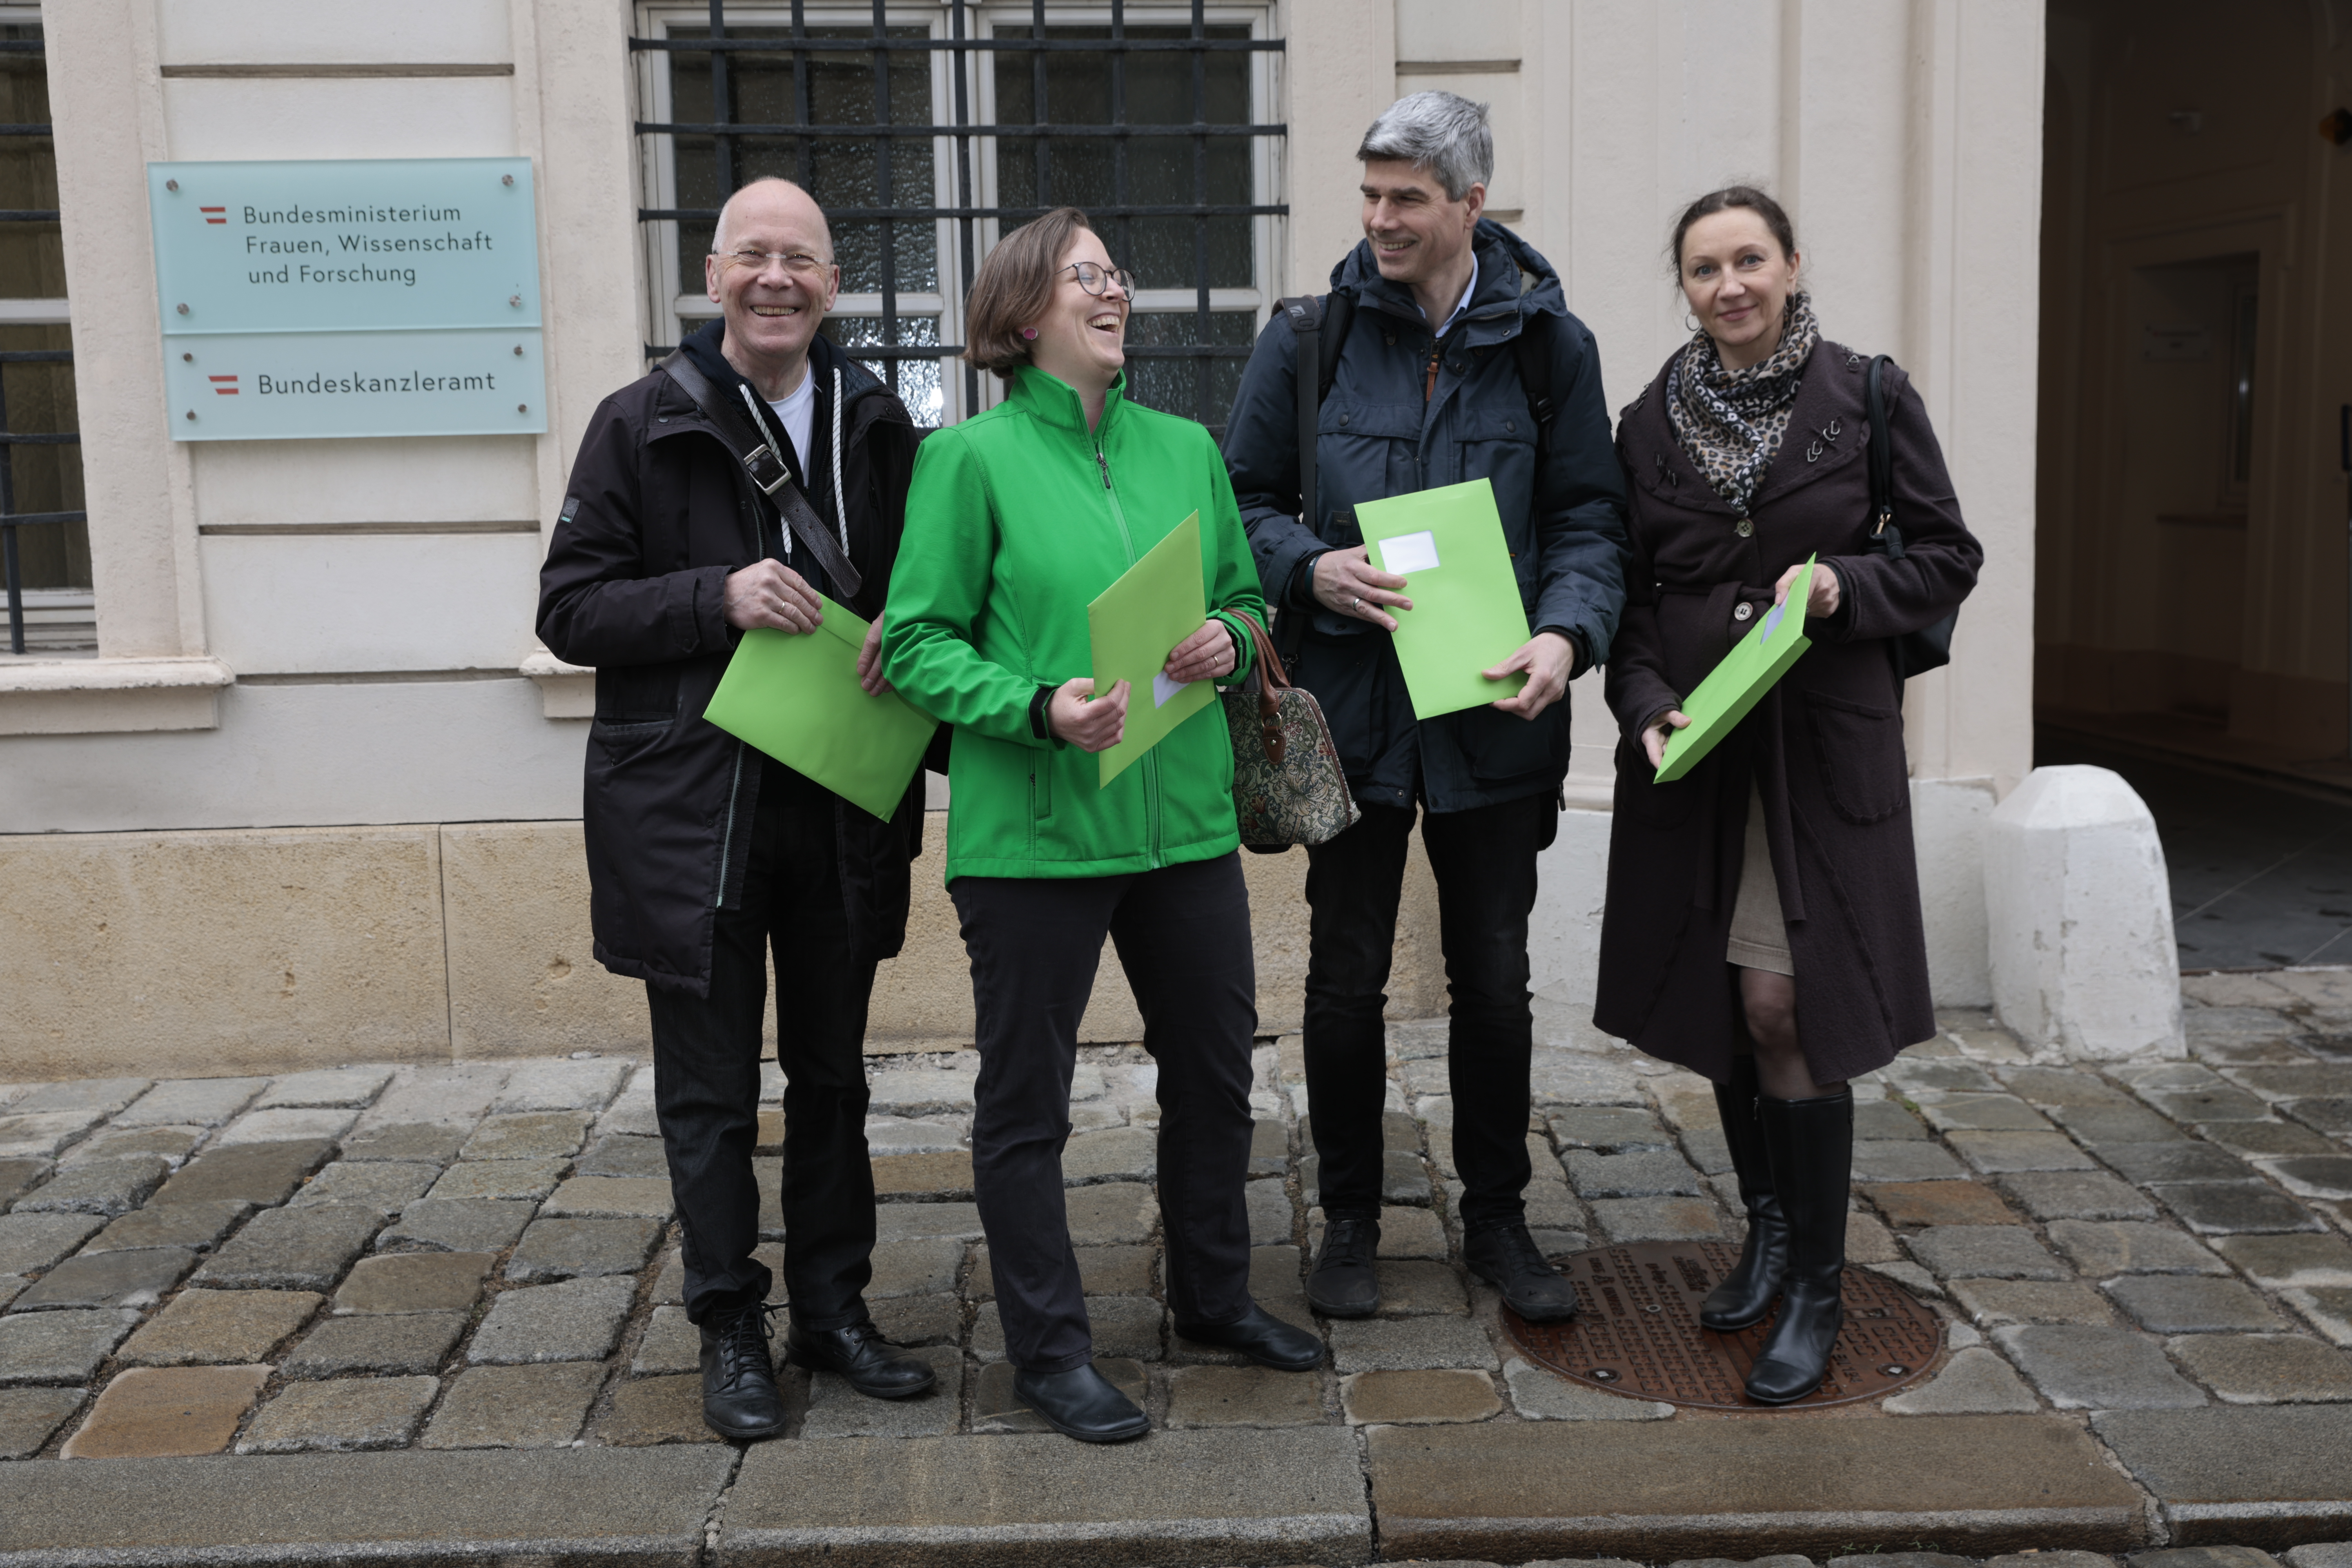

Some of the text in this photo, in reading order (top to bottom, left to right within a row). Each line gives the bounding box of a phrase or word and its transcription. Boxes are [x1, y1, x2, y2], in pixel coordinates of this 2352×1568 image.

[244, 204, 461, 224] Bundesministerium
[246, 231, 493, 256] Frauen, Wissenschaft
[249, 263, 416, 287] und Forschung
[259, 371, 495, 395] Bundeskanzleramt
